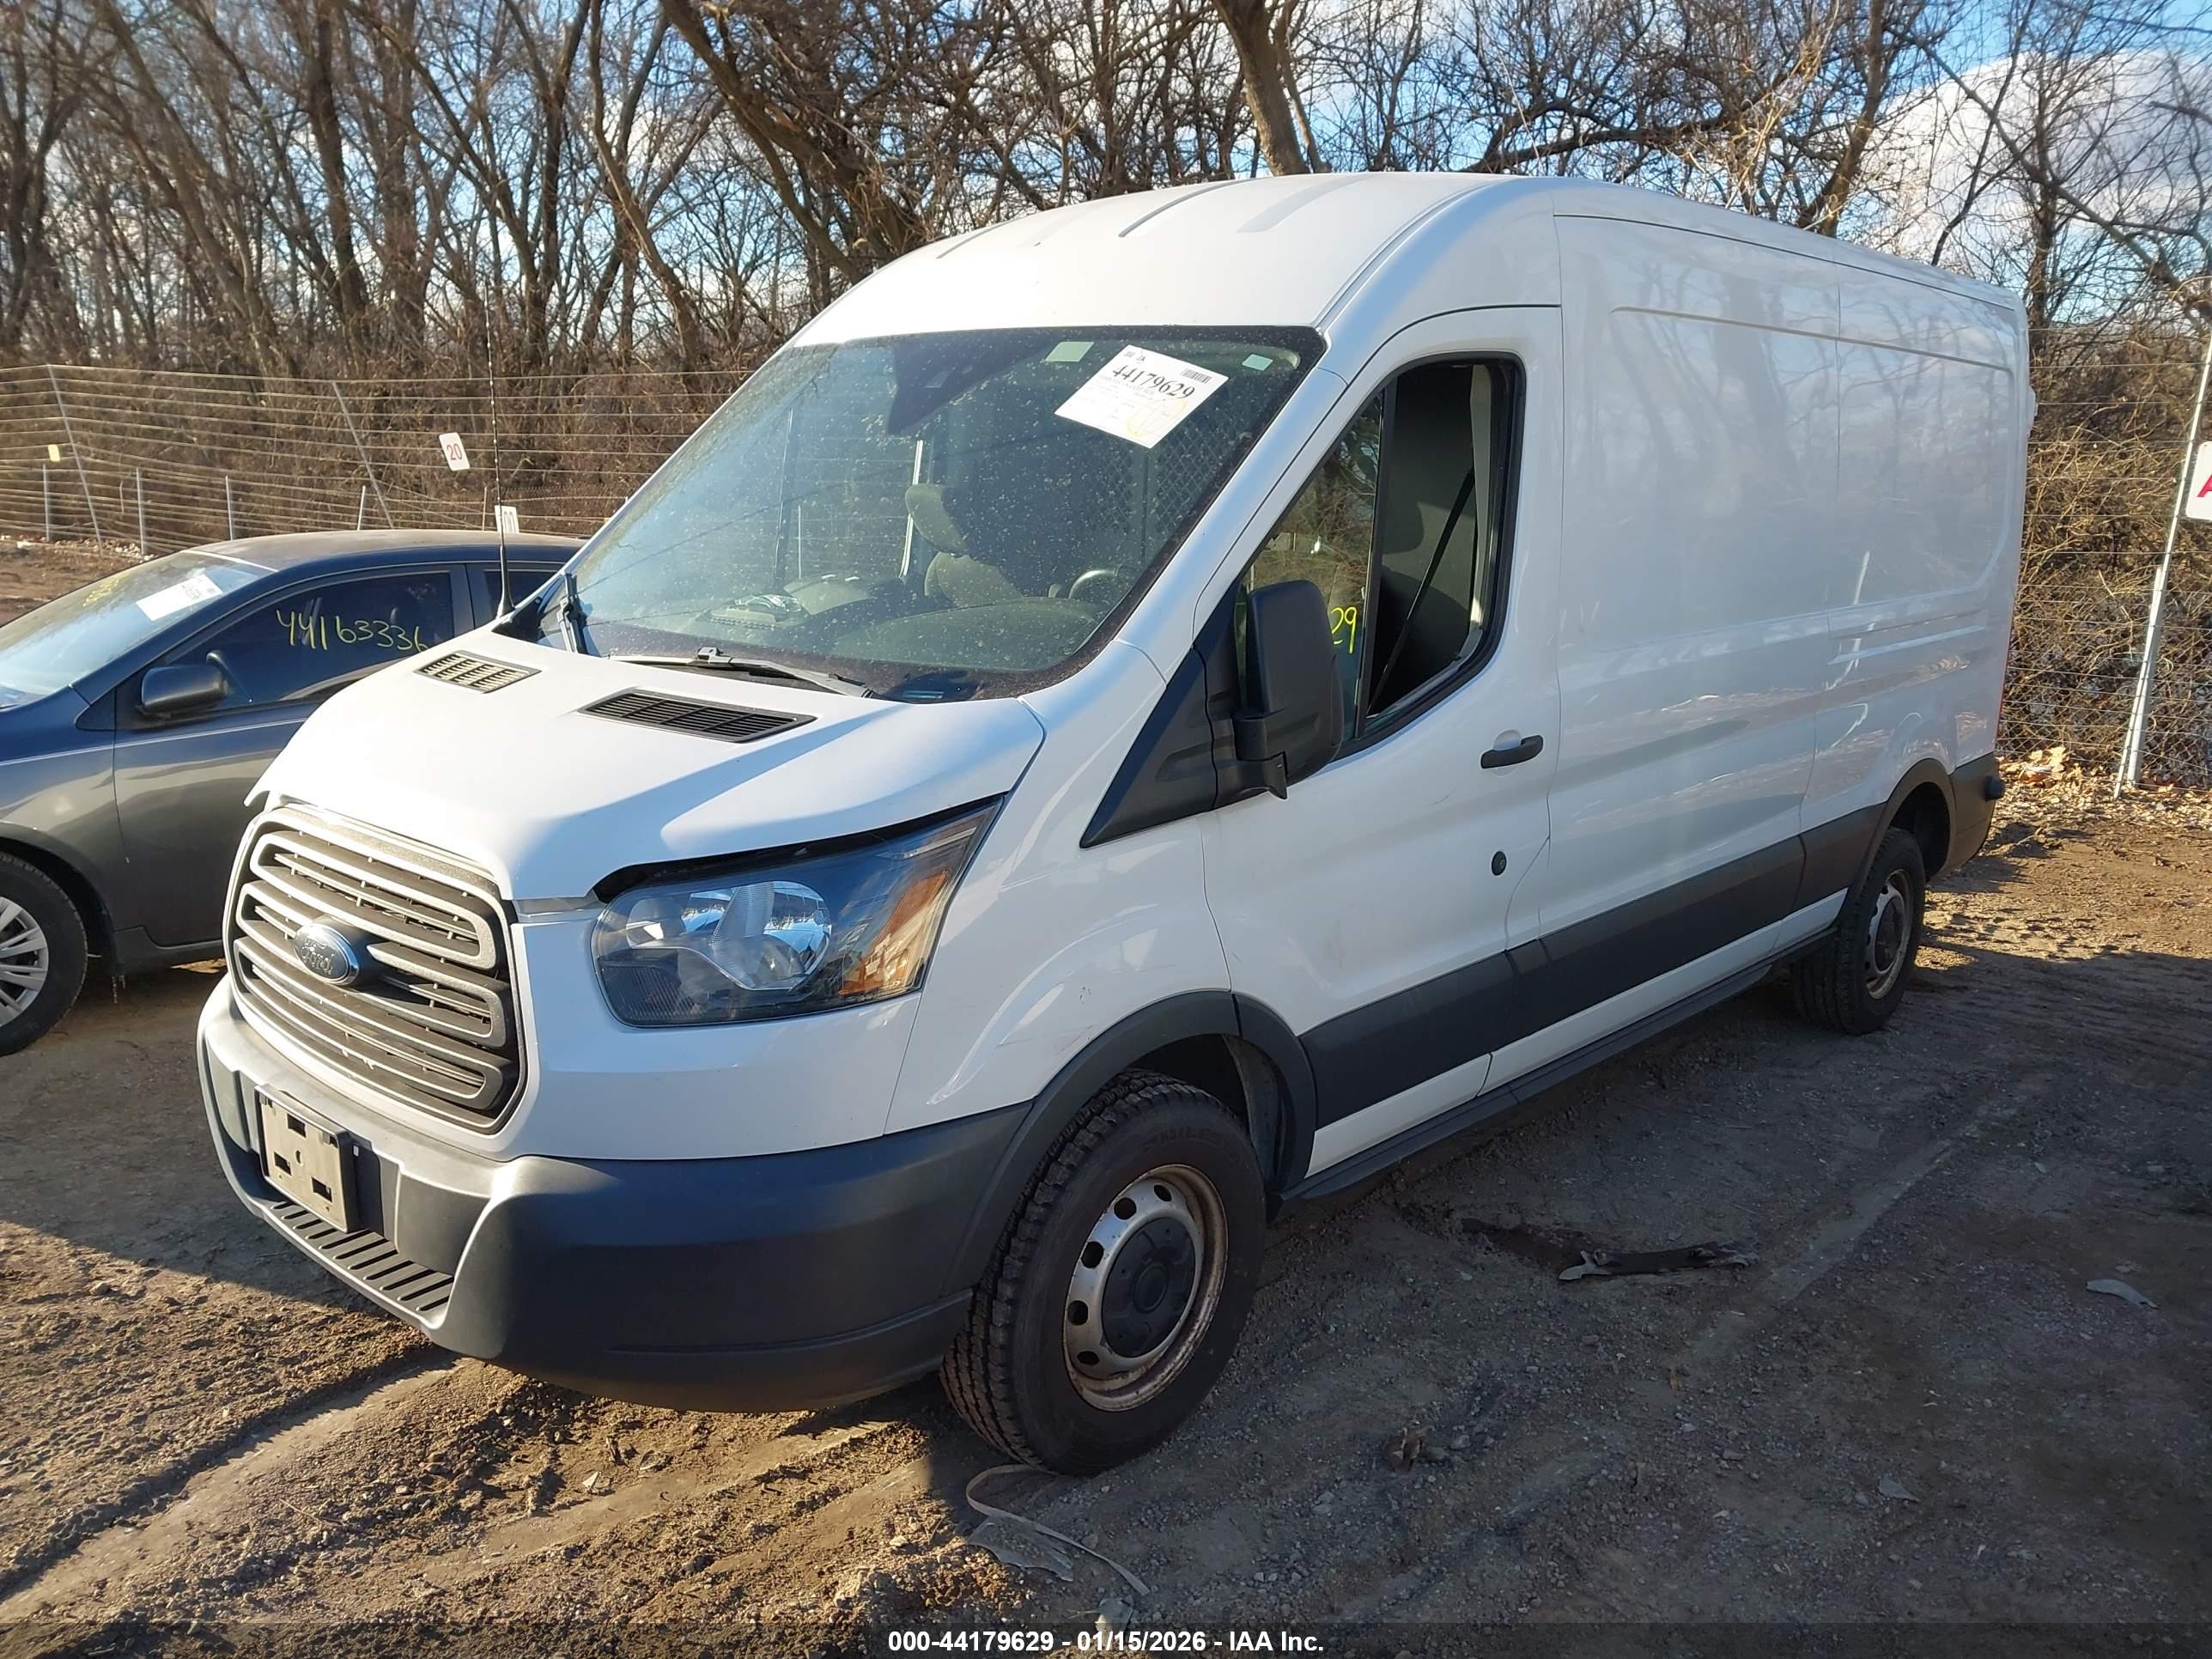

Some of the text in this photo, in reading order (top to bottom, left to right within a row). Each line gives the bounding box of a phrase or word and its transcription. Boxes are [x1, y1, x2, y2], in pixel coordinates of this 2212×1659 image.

[1112, 364, 1196, 400] 44179629
[447, 443, 463, 460] 20
[301, 935, 334, 975] Ford
